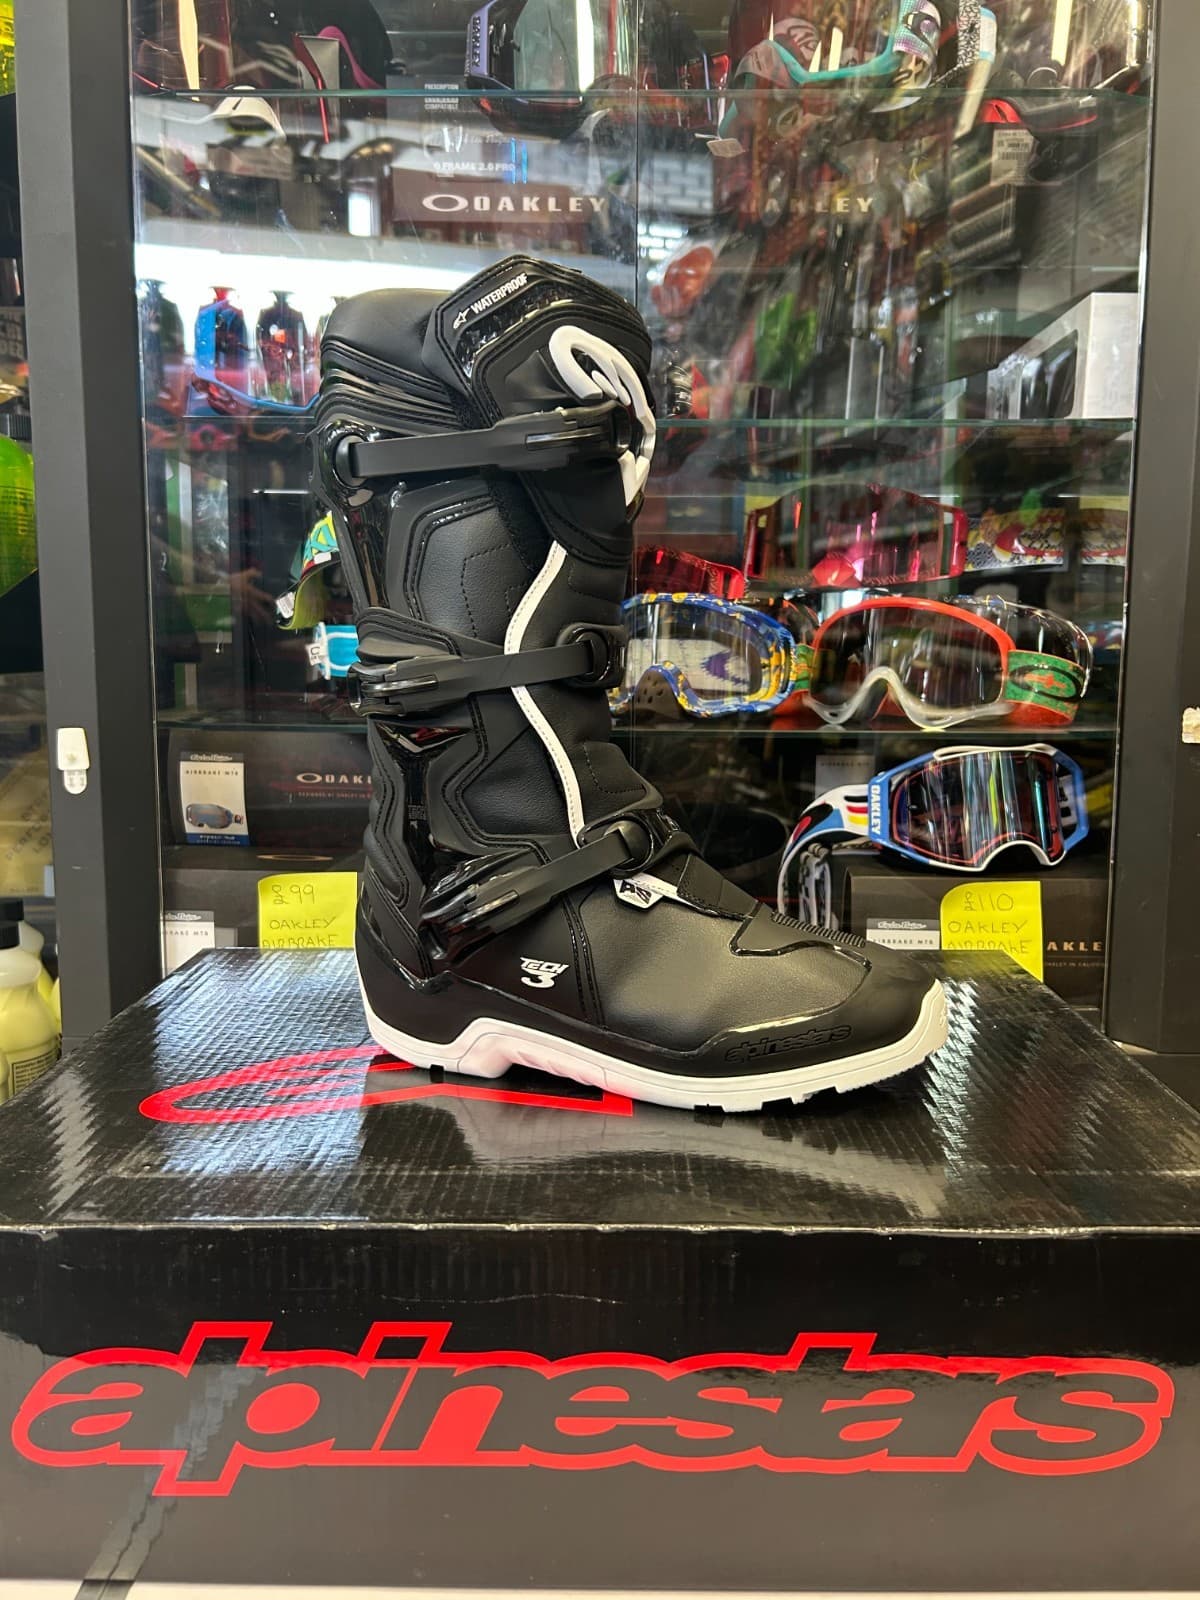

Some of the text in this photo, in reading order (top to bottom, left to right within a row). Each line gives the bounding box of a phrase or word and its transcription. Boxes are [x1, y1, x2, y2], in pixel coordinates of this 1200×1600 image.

[471, 16, 481, 67] OAKLEY
[473, 196, 605, 213] OAKLEY
[470, 272, 528, 314] WATERPROOF
[870, 784, 881, 835] OAKLEY
[271, 883, 316, 905] £99
[963, 890, 1014, 912] £110
[269, 916, 337, 931] OAKLEY
[948, 919, 1029, 935] OAKLEY
[262, 934, 339, 948] AIRBRAKE
[519, 956, 569, 974] TECH
[520, 967, 558, 988] 3
[724, 1024, 852, 1064] alpinestars
[11, 1321, 1175, 1497] alpinestars
